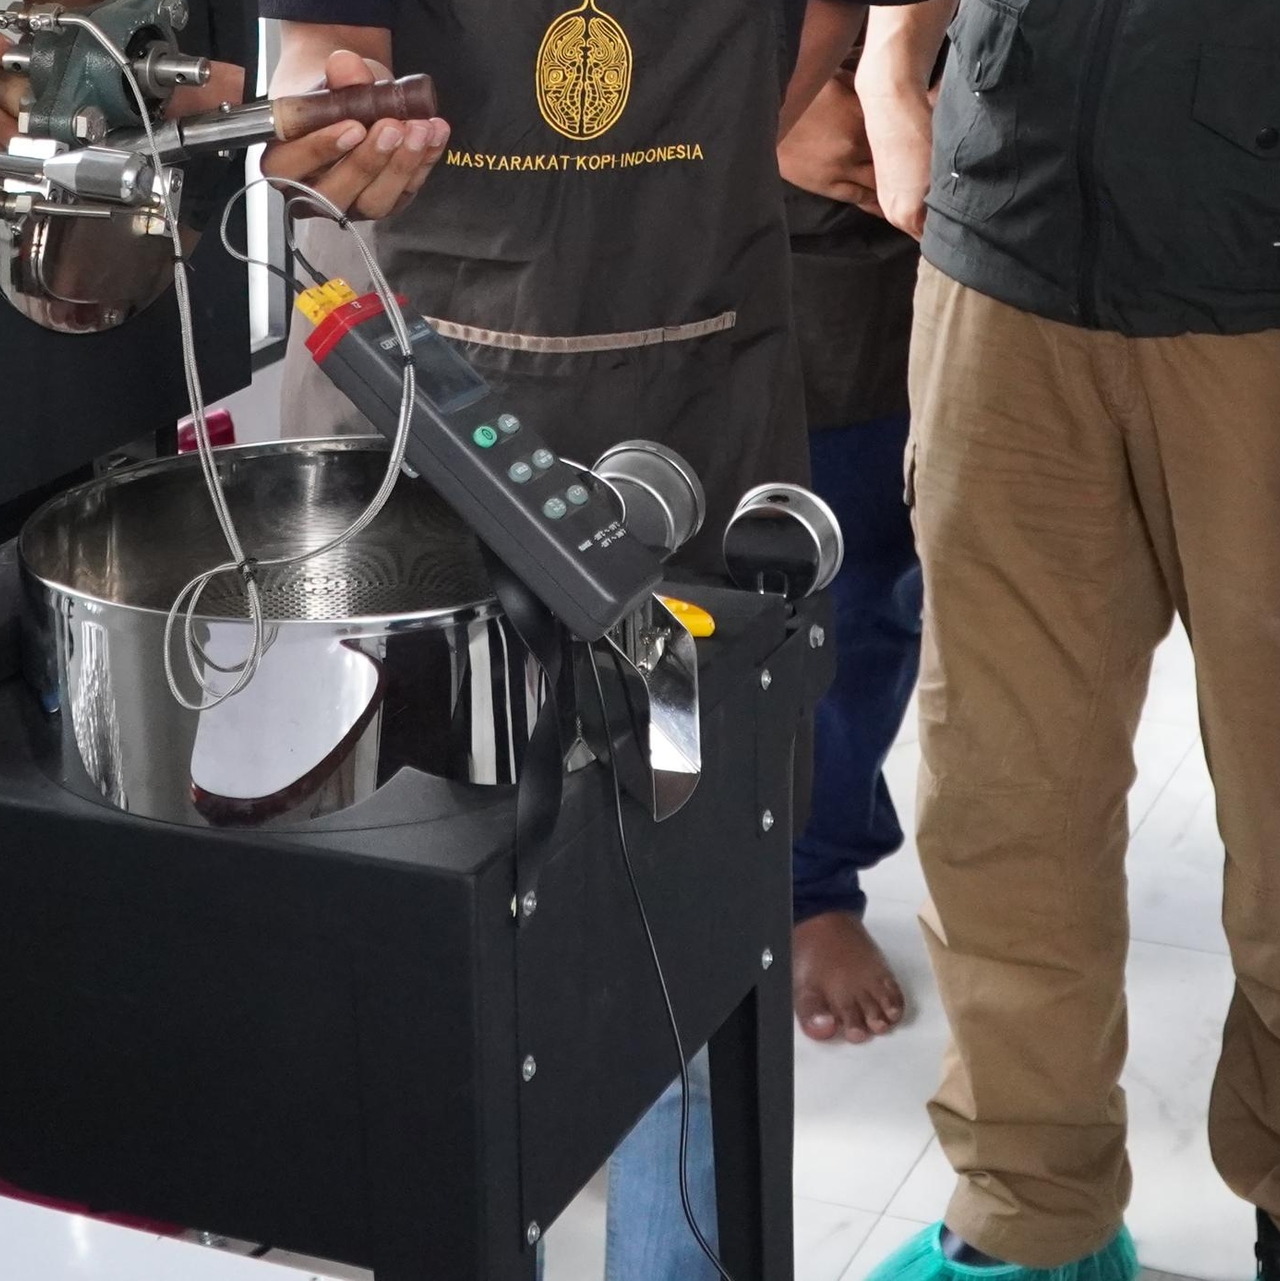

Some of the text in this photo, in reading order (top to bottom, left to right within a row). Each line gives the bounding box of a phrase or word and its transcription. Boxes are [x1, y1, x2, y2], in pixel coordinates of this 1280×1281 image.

[447, 144, 704, 171] MASYARAKAT KOPI INDONESIA
